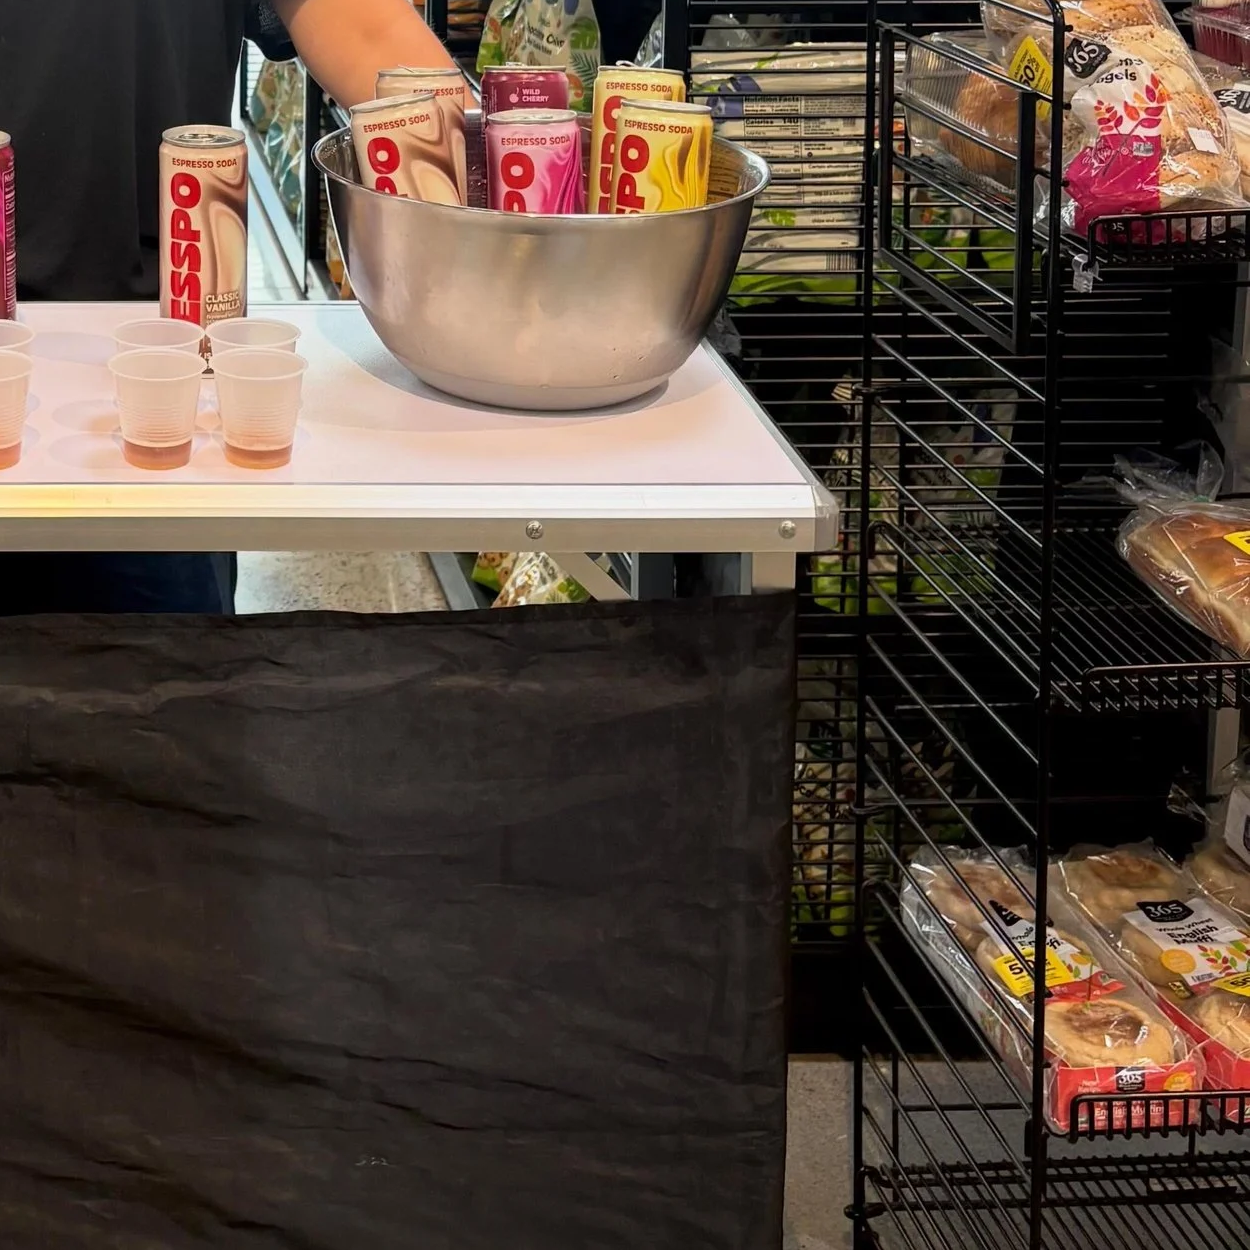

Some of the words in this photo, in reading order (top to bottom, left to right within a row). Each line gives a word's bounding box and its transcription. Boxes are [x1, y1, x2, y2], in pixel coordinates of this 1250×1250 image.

[606, 82, 648, 90] ESPRESSO
[650, 85, 673, 93] SODA
[363, 119, 407, 133] ESPRESSO
[409, 114, 430, 125] SODA
[624, 119, 665, 132] ESPRESSO
[668, 125, 693, 134] SODA
[501, 137, 546, 146] ESPRESSO
[550, 134, 570, 145] SODA
[172, 158, 214, 169] ESPRESSO
[217, 158, 237, 168] SODA
[171, 172, 201, 324] ESSPO
[206, 291, 239, 303] CLASSIC
[206, 301, 240, 312] VANILLA
[1146, 904, 1183, 918] 365
[1167, 925, 1219, 939] English
